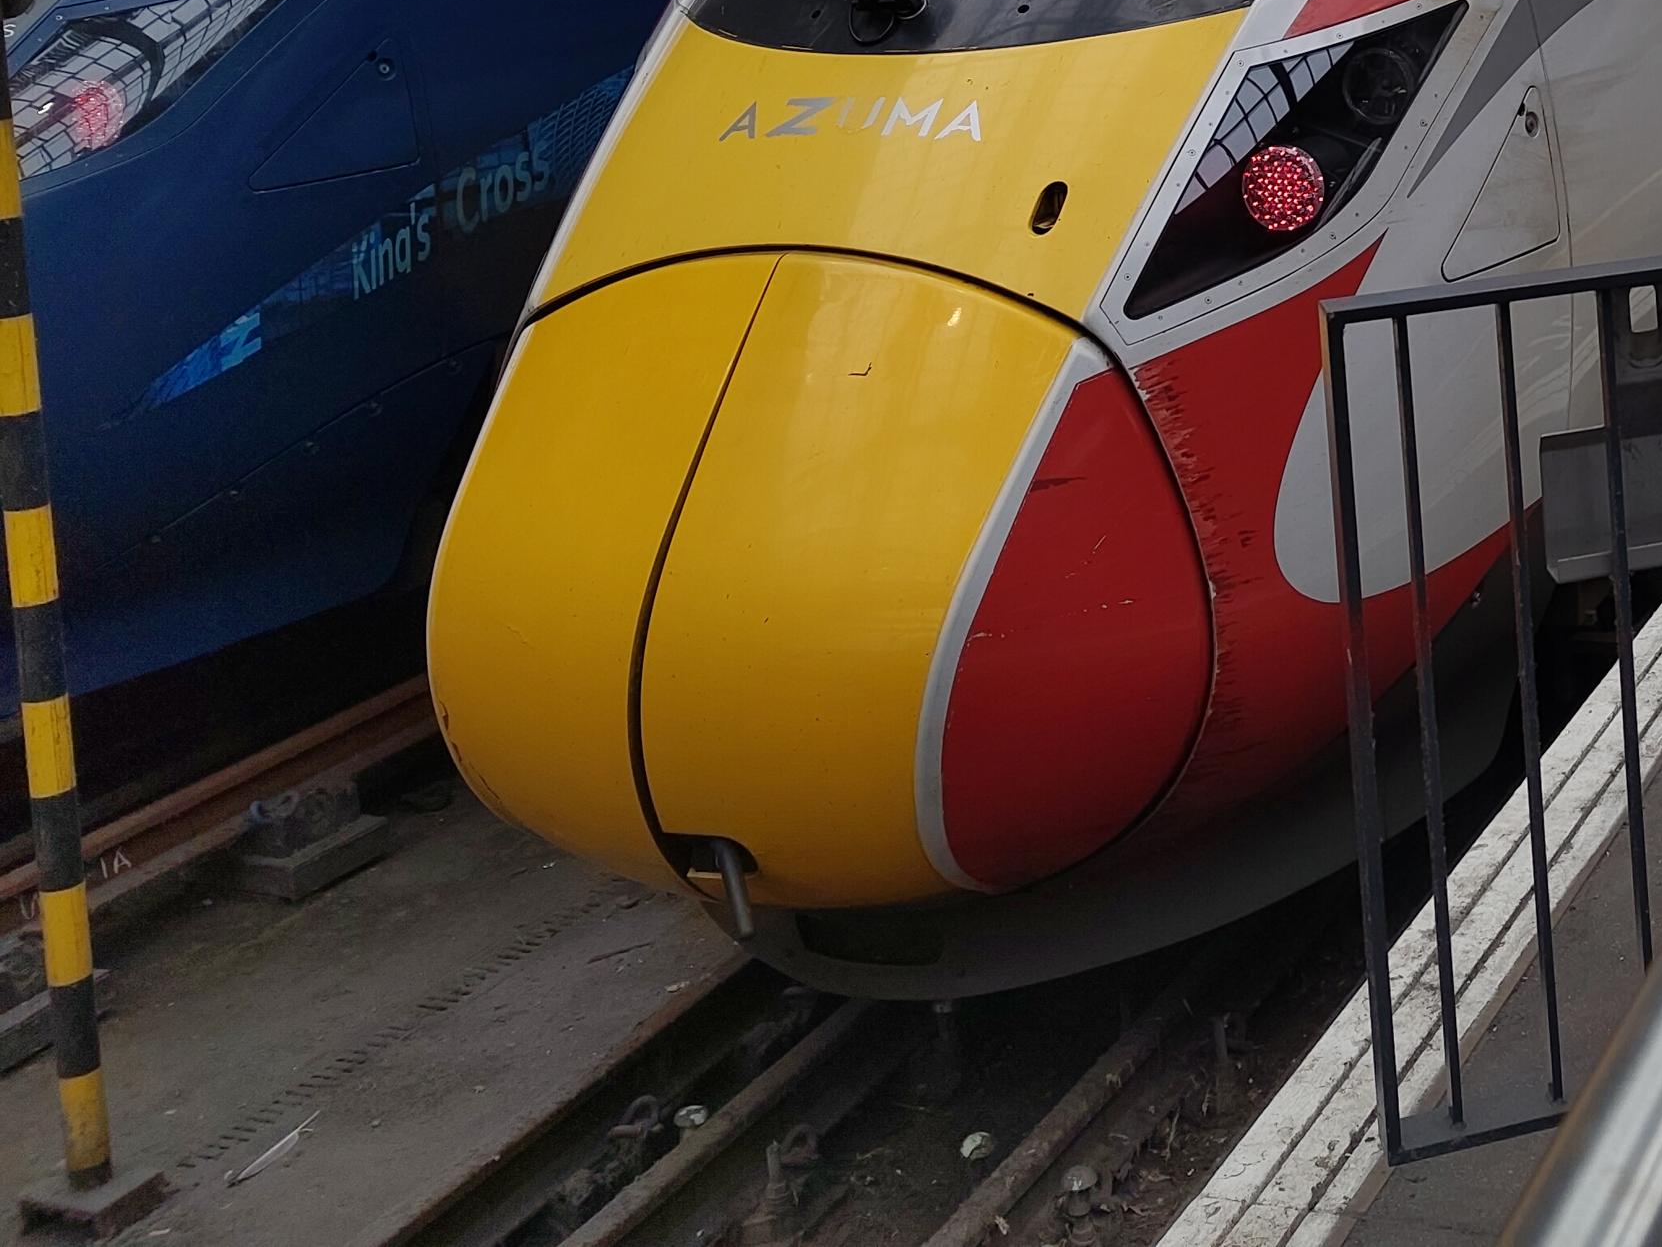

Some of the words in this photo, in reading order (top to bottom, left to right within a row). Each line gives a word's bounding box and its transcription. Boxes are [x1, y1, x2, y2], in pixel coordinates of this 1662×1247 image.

[718, 96, 981, 142] AZUMA
[352, 201, 431, 301] King's
[456, 149, 550, 234] Cross
